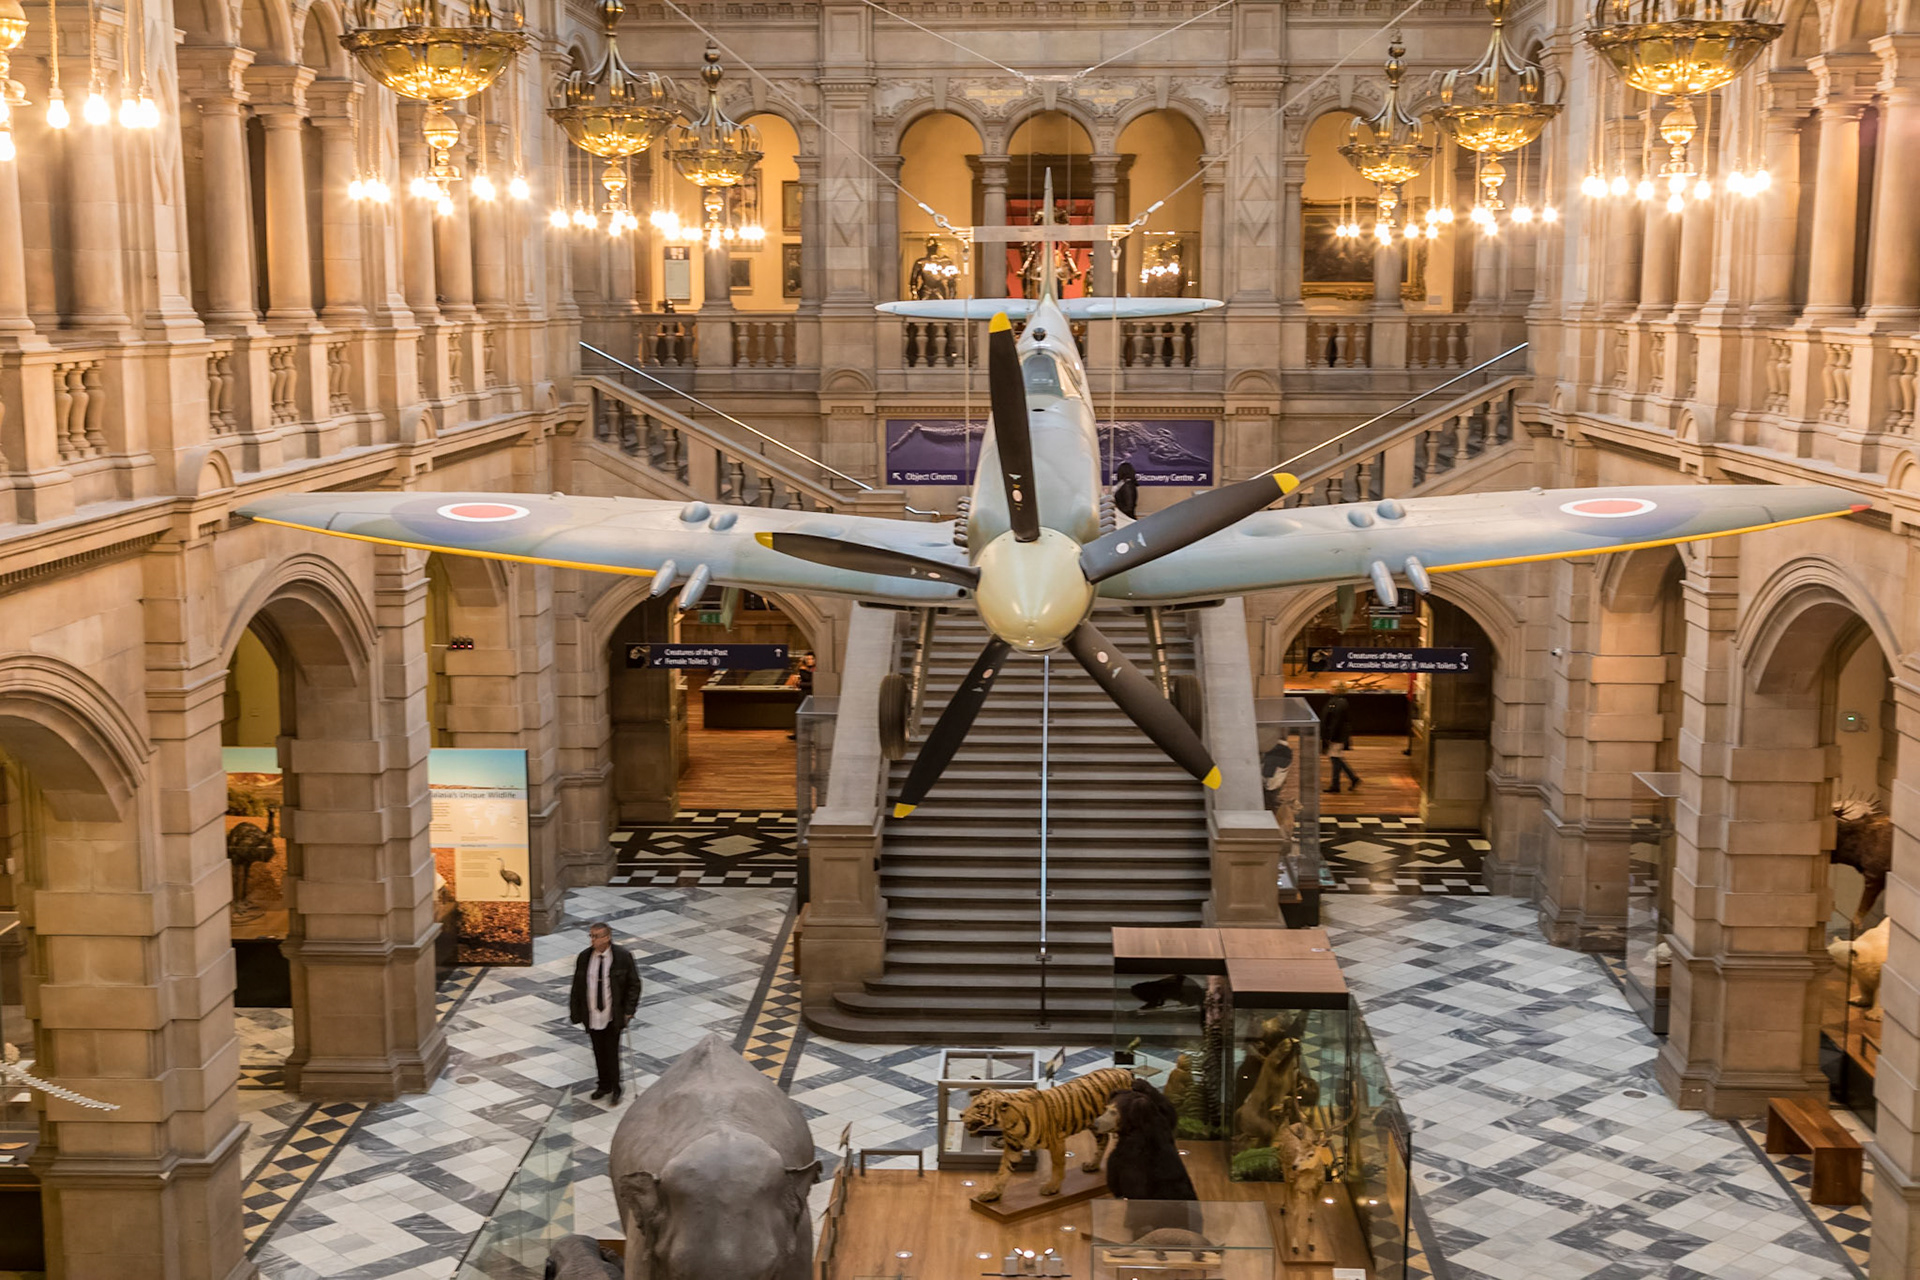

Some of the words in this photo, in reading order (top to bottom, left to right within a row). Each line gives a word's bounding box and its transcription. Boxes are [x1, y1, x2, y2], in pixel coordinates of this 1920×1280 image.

[905, 472, 929, 481] Object
[930, 472, 958, 480] Cinema
[1135, 473, 1169, 482] Discovery
[1170, 473, 1194, 481] Centre
[664, 648, 694, 656] Creatures
[713, 648, 728, 656] Past
[1347, 652, 1378, 660] Creatures
[1397, 652, 1412, 660] Past
[665, 657, 687, 665] Female
[687, 657, 708, 665] Toilets
[1347, 661, 1380, 669] Accessible
[1381, 661, 1398, 669] Toilet
[1435, 662, 1457, 670] Toilets
[460, 791, 485, 799] Unique
[488, 791, 516, 799] Wildlife
